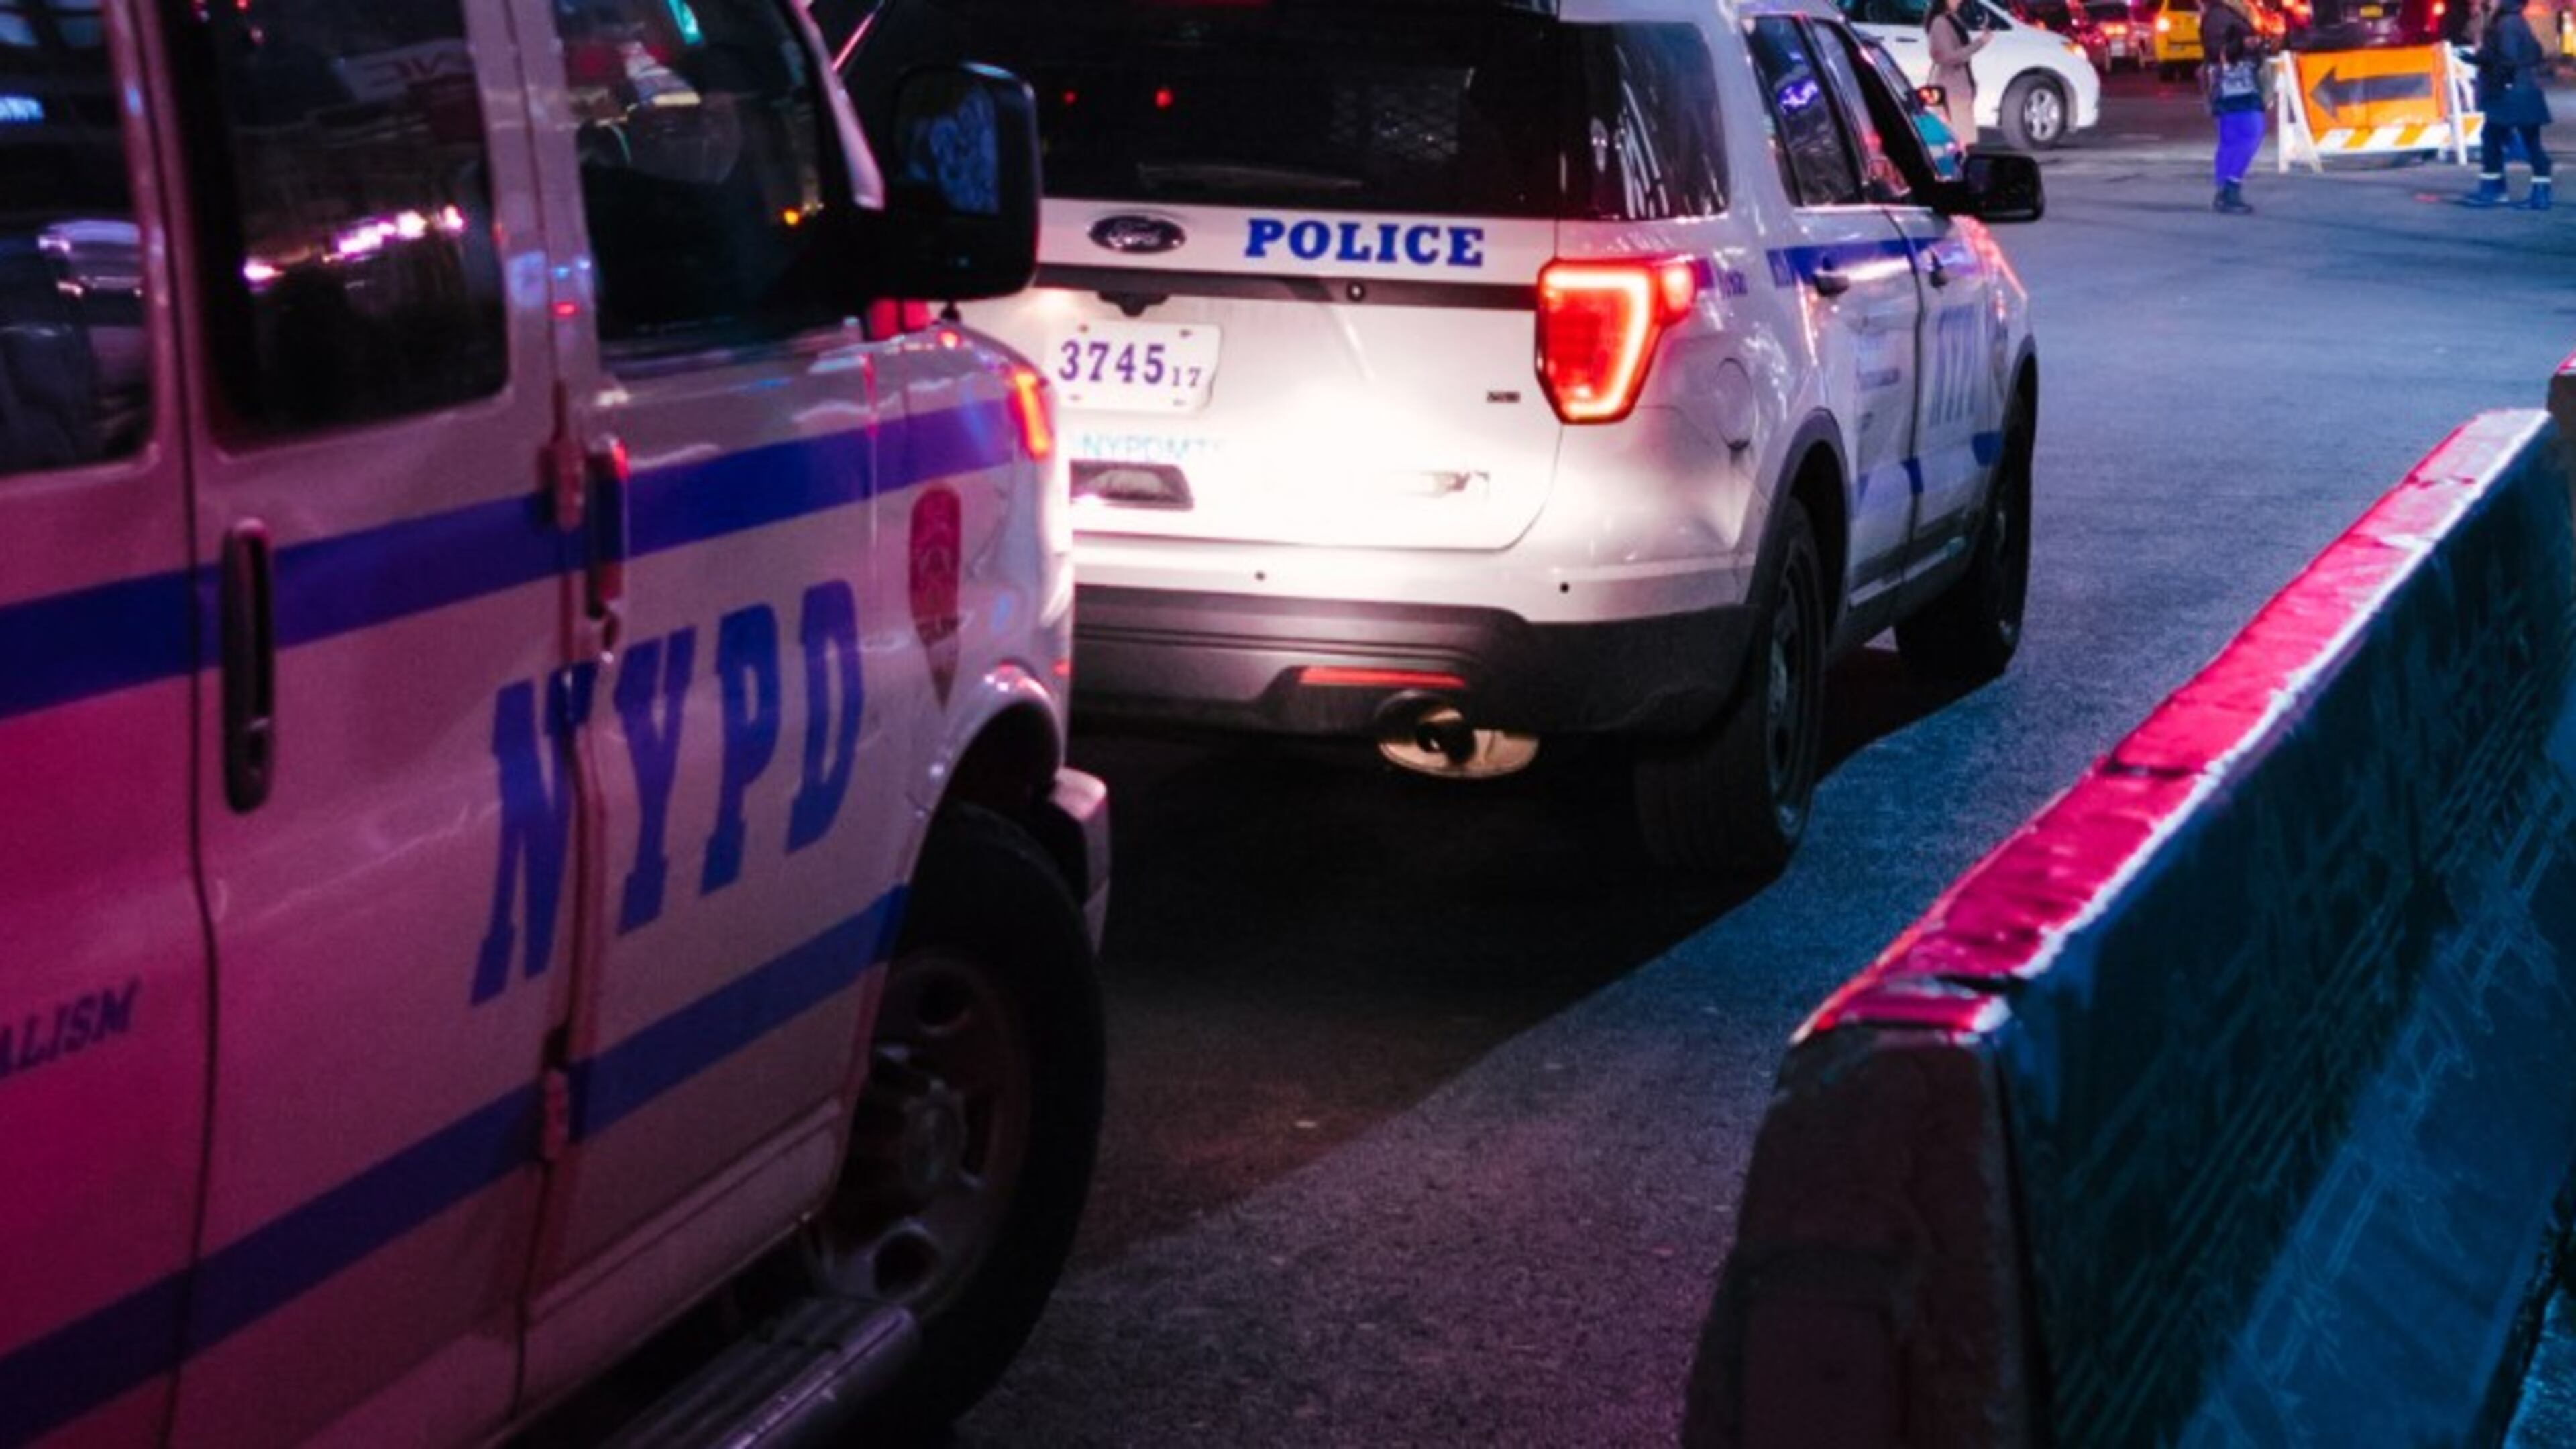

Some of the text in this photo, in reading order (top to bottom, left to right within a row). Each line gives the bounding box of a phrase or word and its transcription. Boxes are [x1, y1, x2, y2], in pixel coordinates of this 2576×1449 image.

[1244, 218, 1483, 266] POLICE
[1058, 340, 1201, 387] 3745 17
[472, 578, 863, 1006] NYPD
